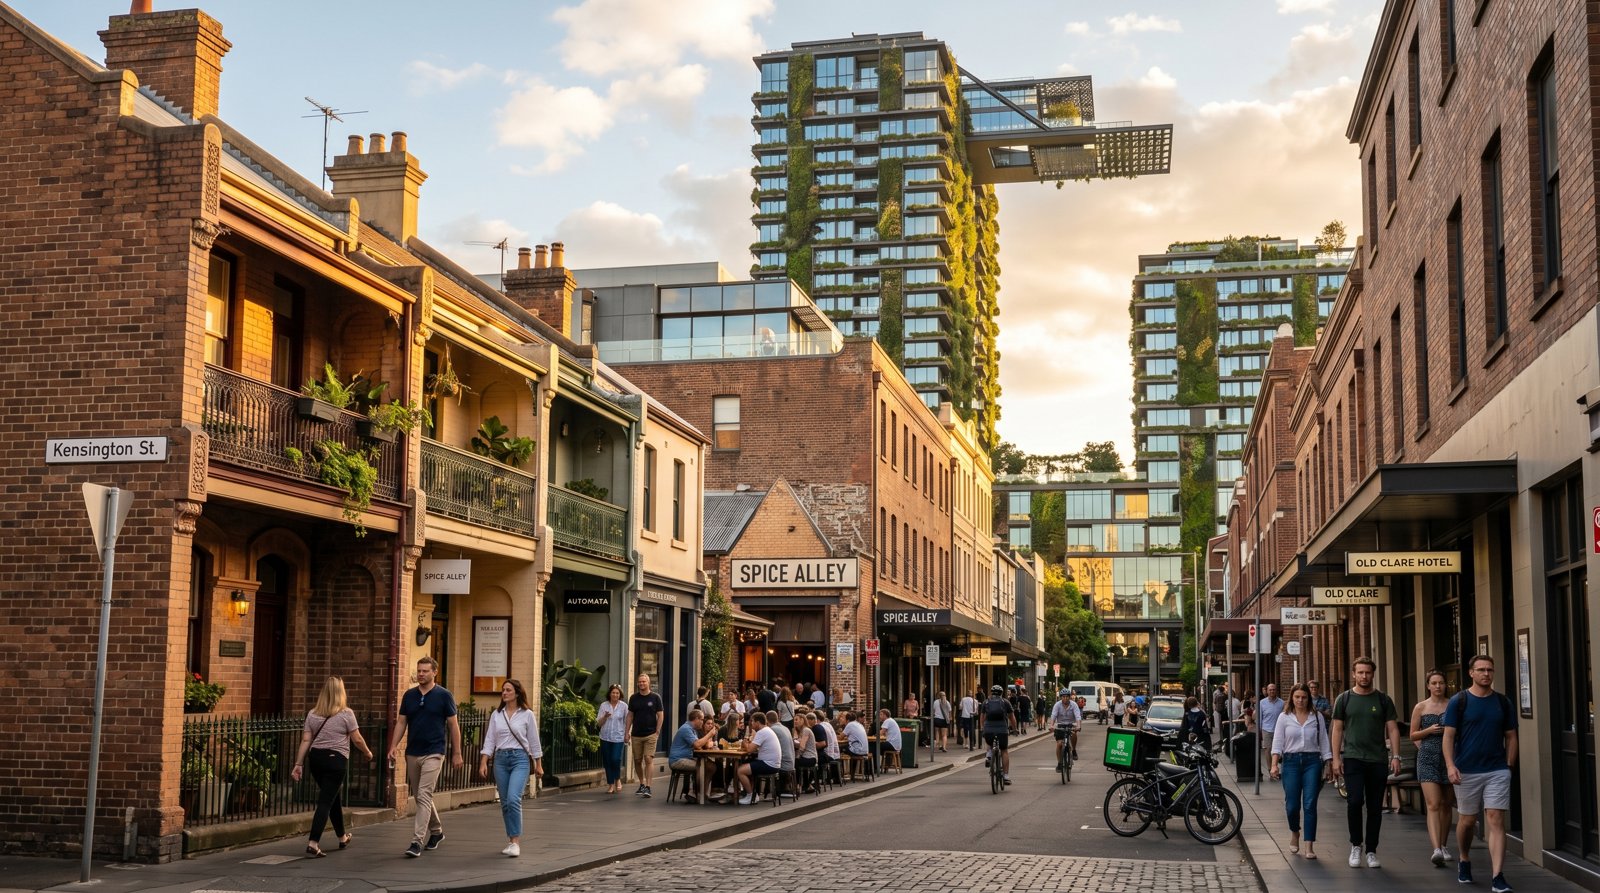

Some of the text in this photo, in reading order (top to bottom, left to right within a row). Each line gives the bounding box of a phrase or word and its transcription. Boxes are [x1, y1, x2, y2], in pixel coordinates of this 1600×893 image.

[53, 440, 158, 459] Kensington St.
[1356, 558, 1453, 567] OLD CLARE HOTEL
[740, 563, 847, 583] SPICE ALLEY
[1325, 589, 1379, 598] OLD CLARE
[883, 612, 938, 623] SPICE ALLEY
